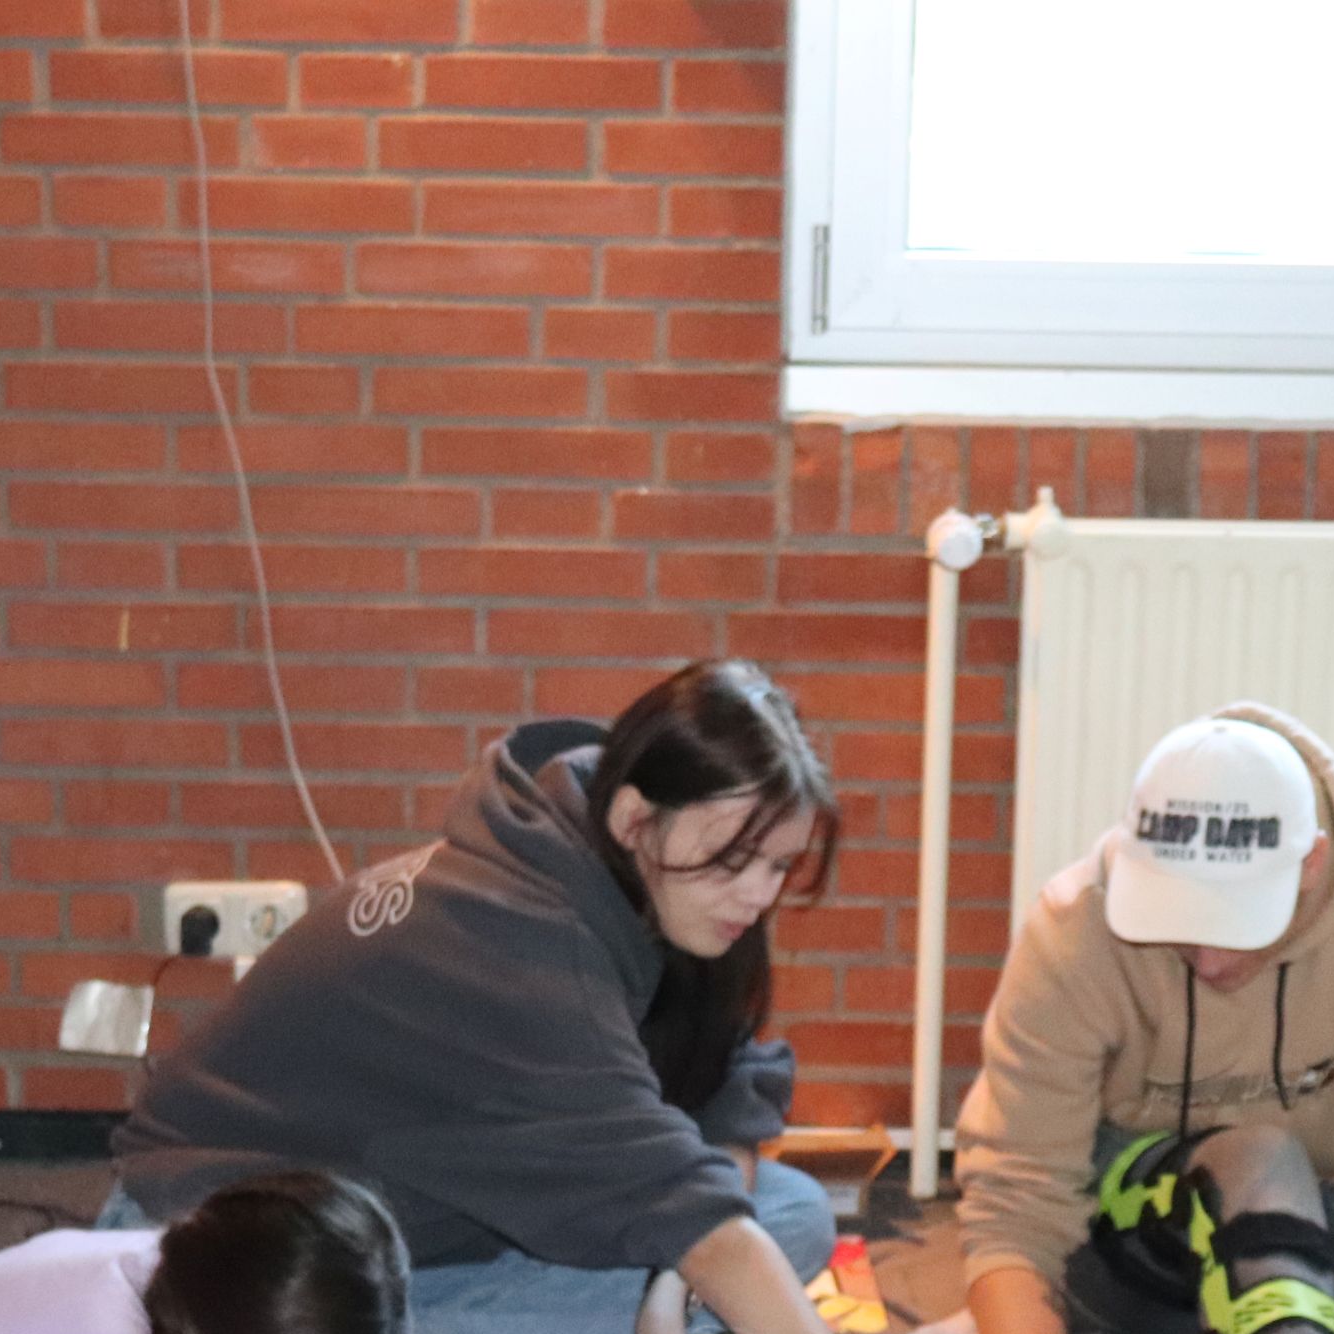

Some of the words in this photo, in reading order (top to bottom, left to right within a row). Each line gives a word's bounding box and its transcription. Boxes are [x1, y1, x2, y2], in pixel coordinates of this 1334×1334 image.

[1137, 809, 1198, 844] CAMP
[1205, 816, 1280, 849] DAVID
[1155, 848, 1196, 860] UNDER
[1207, 851, 1252, 863] WATER
